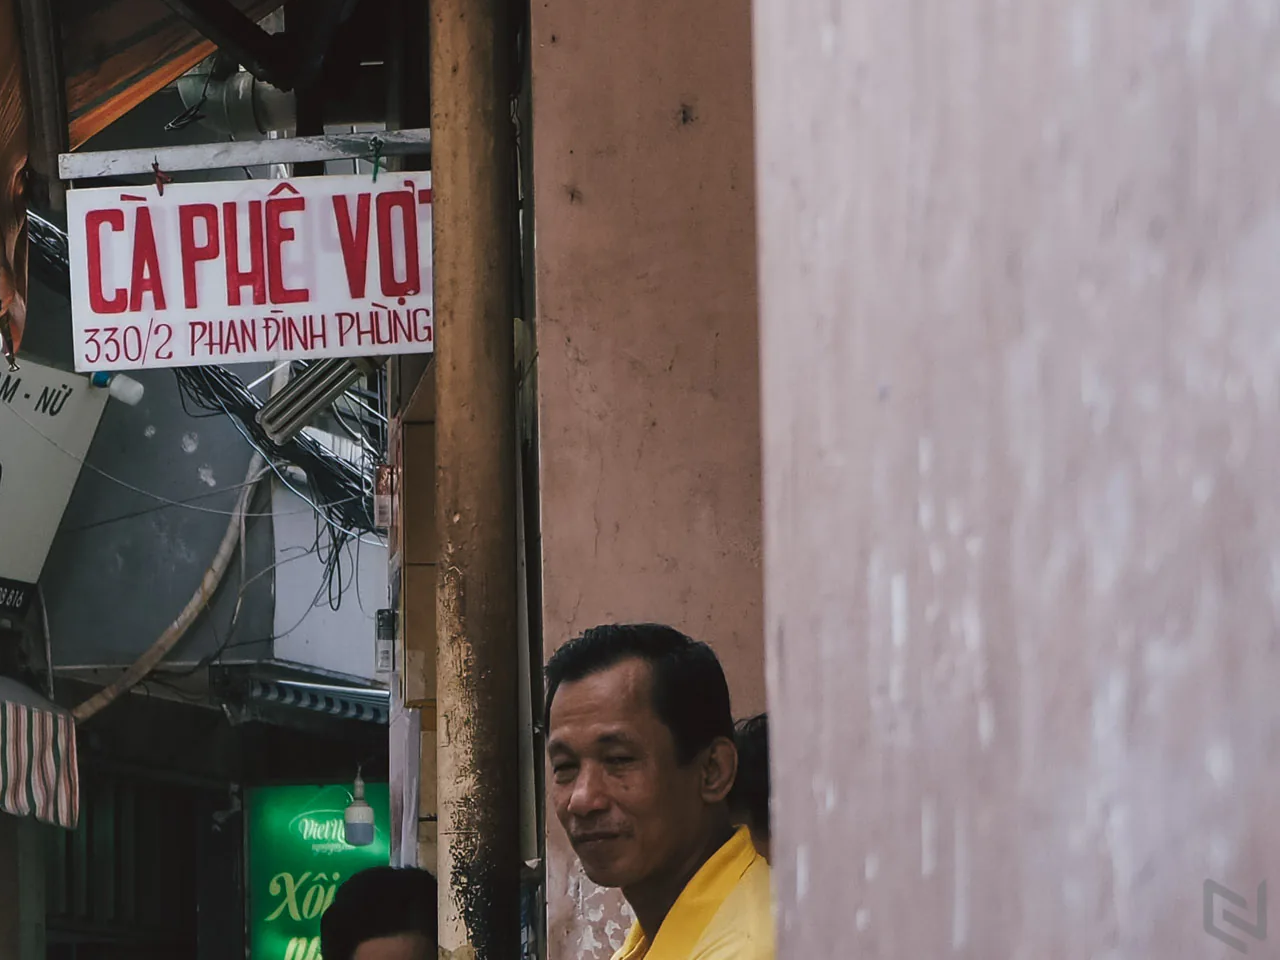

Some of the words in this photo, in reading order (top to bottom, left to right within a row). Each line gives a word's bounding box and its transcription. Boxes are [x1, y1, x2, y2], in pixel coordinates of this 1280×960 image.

[85, 193, 167, 315] CÀ
[178, 181, 310, 310] PHÊ
[84, 317, 174, 366] 330/2
[188, 318, 258, 357] PHAN
[334, 302, 432, 347] PHÙNG
[34, 383, 74, 417] NỮ
[264, 871, 341, 922] Xôi
